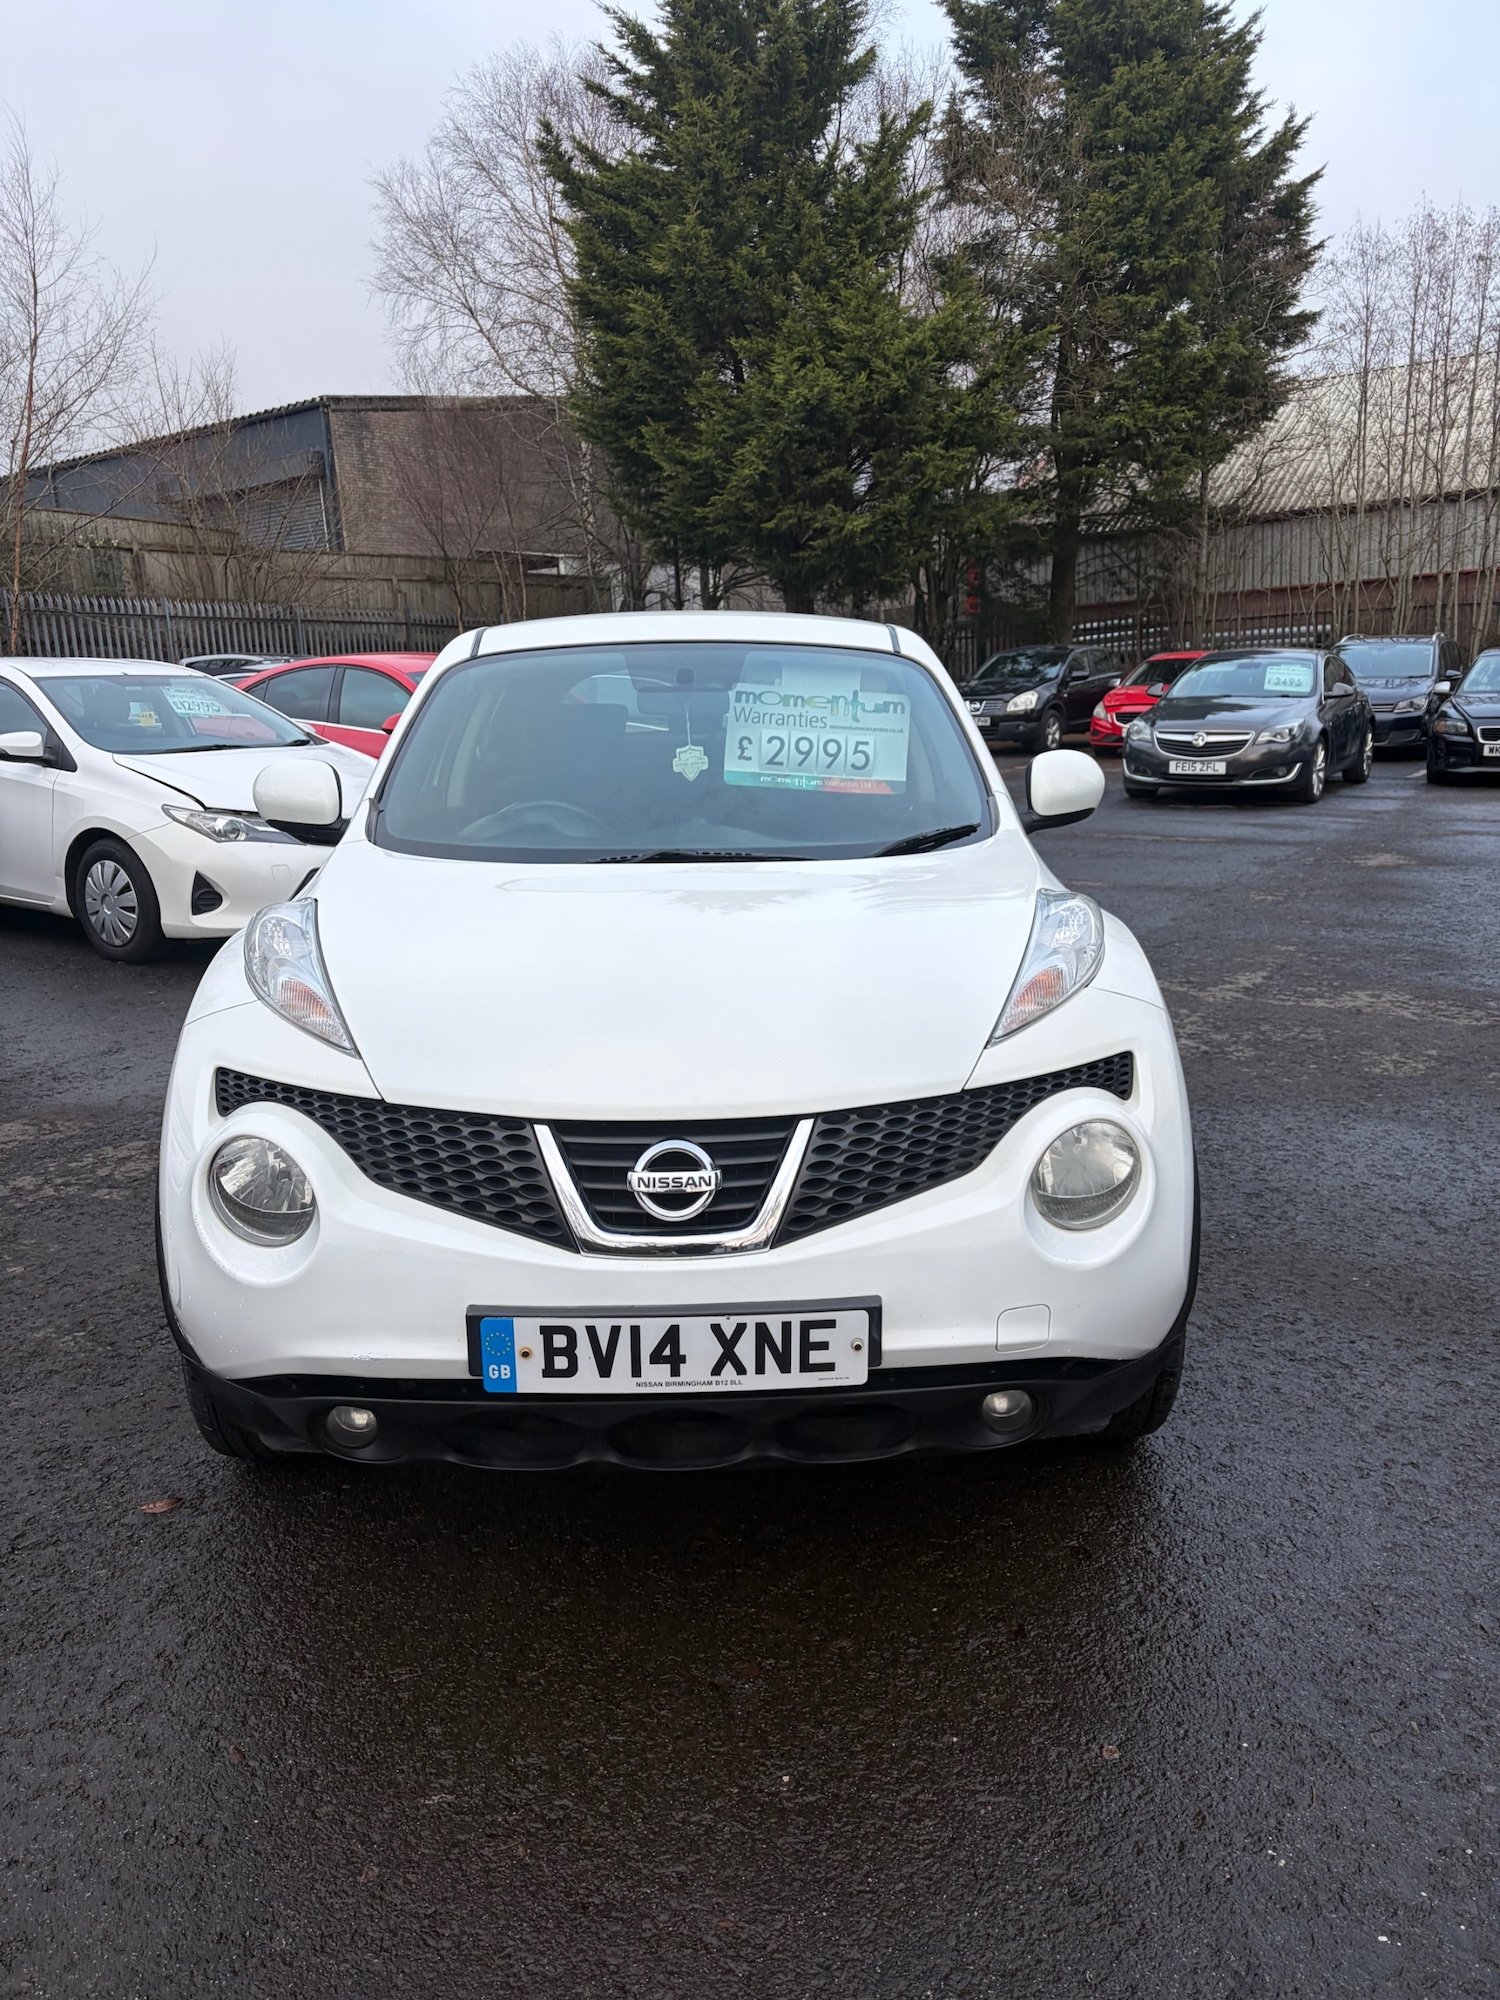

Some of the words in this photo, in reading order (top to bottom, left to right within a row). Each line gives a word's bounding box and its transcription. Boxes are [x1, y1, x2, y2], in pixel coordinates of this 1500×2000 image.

[735, 690, 906, 723] momentum
[733, 706, 828, 729] Warranties
[1175, 762, 1197, 772] FE15
[1200, 762, 1220, 772] ZFL
[637, 1175, 712, 1188] NISSAN
[539, 1324, 686, 1378] BV14
[710, 1319, 837, 1376] XNE
[488, 1364, 511, 1379] GB
[665, 1380, 713, 1388] BIRMINGHAM
